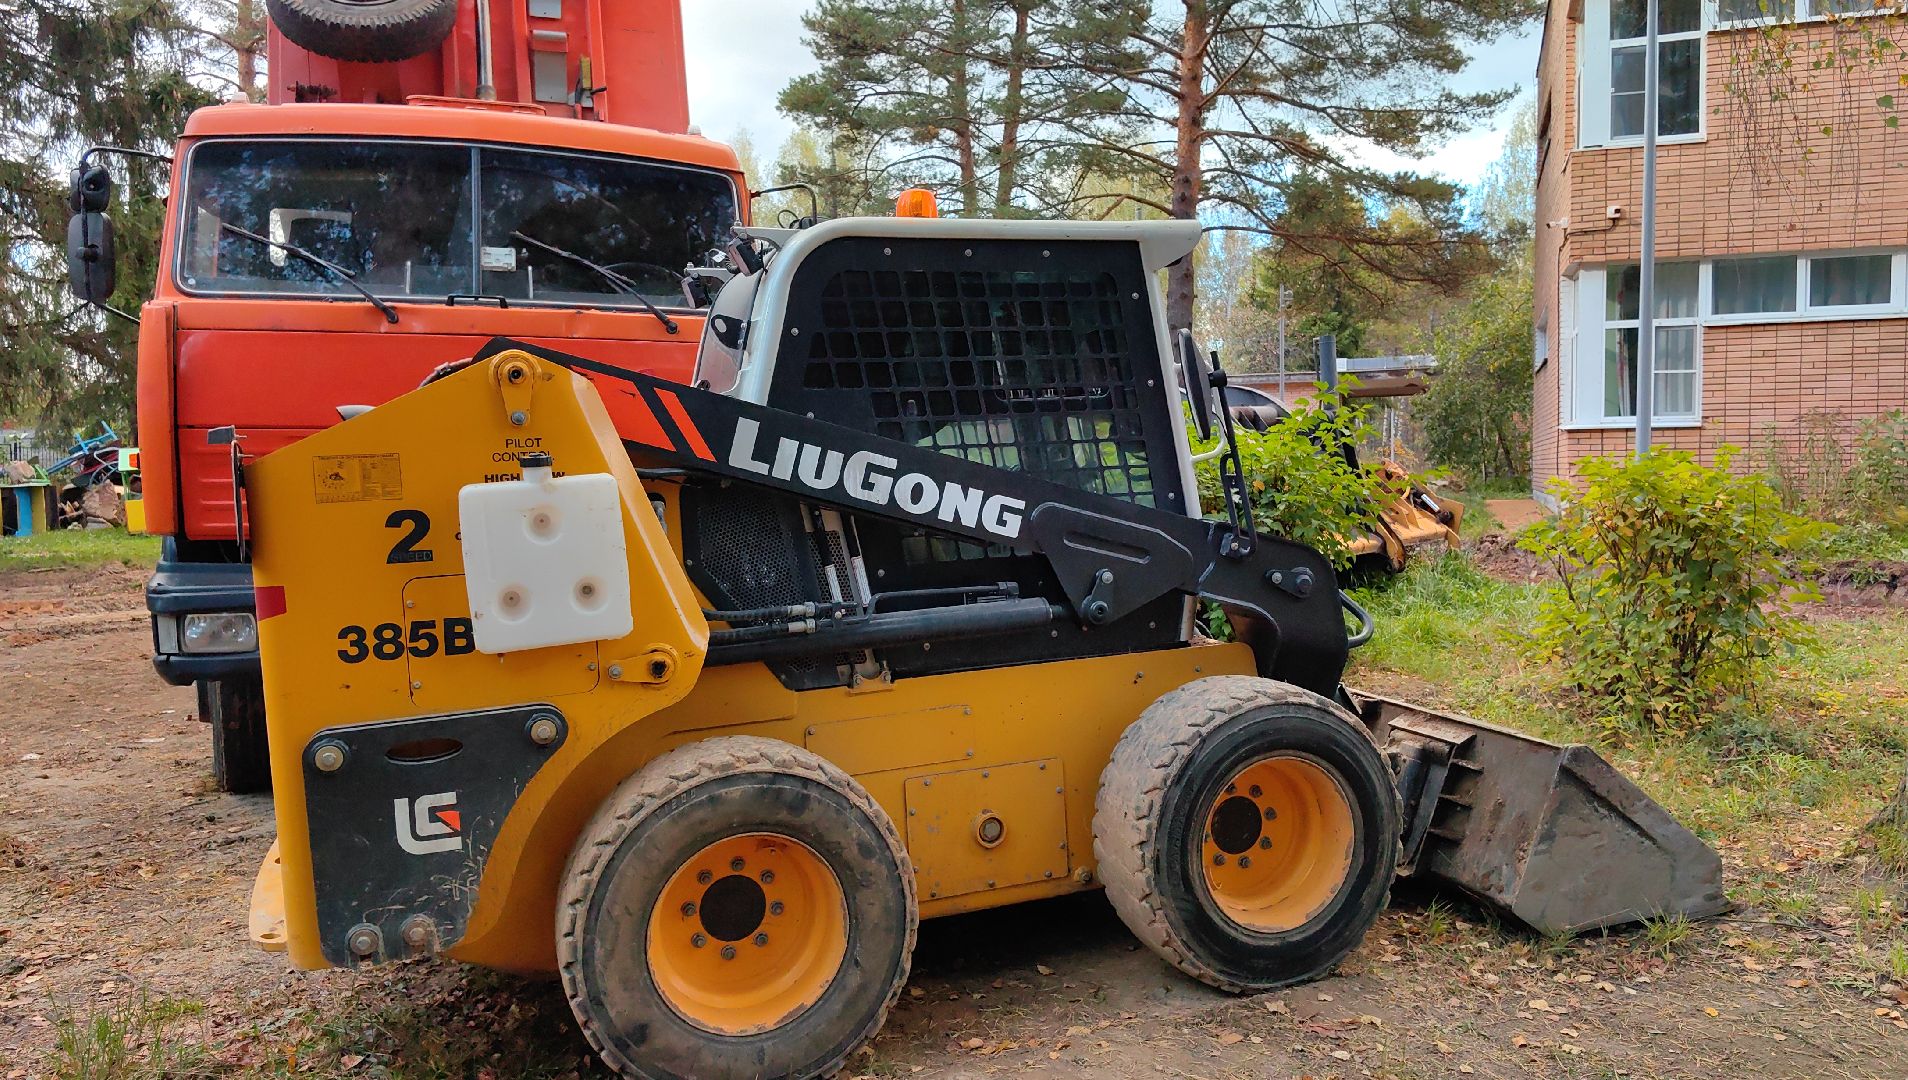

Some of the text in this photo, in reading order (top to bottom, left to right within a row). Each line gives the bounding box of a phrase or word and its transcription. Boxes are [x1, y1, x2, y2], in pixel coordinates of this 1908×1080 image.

[505, 438, 542, 448] PILOT
[492, 450, 555, 463] CONTL
[484, 472, 521, 483] HIGH
[385, 509, 434, 565] 2
[337, 616, 476, 664] 385B
